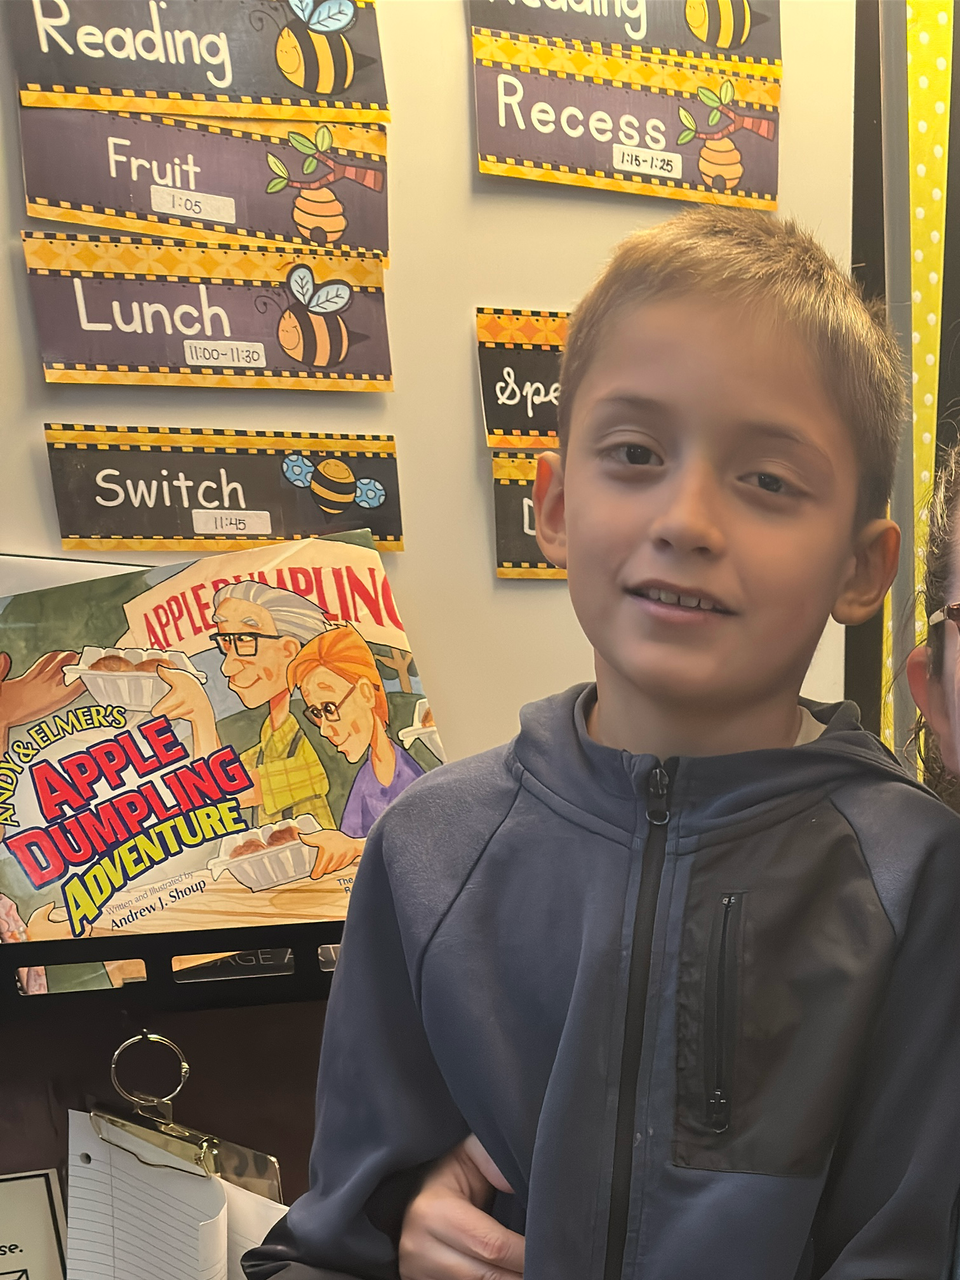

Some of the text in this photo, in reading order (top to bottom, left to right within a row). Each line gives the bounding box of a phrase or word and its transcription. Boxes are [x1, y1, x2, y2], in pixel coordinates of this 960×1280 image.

[33, 0, 233, 89] Reading
[497, 74, 666, 151] Recess
[107, 137, 201, 190] Fruit
[170, 193, 203, 215] 1:05
[73, 277, 231, 338] Lunch
[95, 468, 246, 510] Switch
[213, 516, 247, 531] 11:45
[143, 583, 217, 651] APPLE
[13, 741, 40, 763] &
[28, 705, 127, 749] ELMER'S
[30, 716, 187, 823] APPLE
[5, 746, 251, 889] DUMPLING
[64, 800, 246, 936] ADVENTURE
[105, 897, 133, 916] Written
[134, 889, 149, 904] and
[110, 878, 207, 931] Andrew J. Shoup
